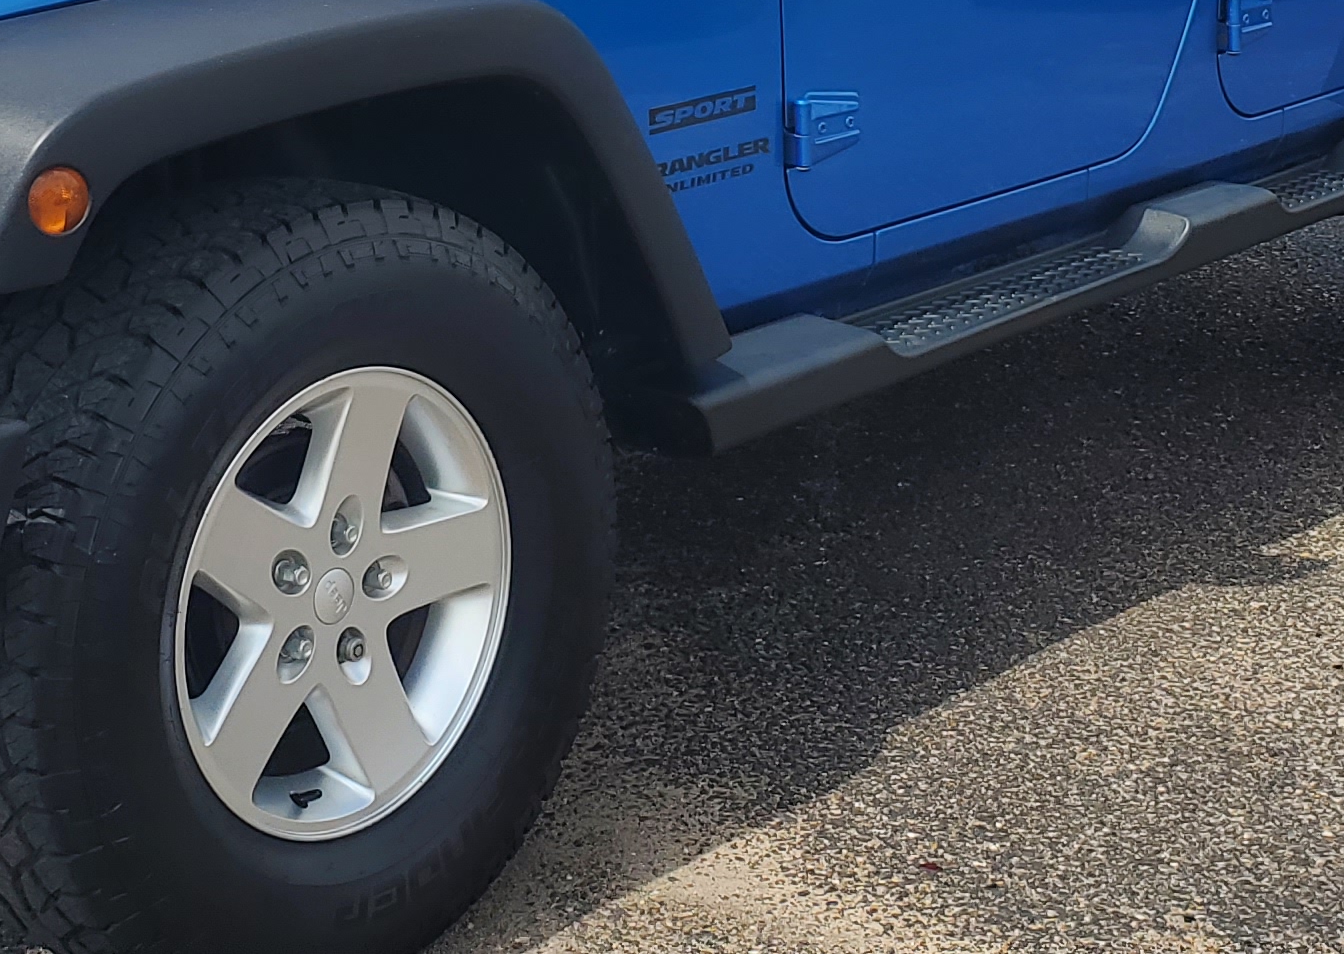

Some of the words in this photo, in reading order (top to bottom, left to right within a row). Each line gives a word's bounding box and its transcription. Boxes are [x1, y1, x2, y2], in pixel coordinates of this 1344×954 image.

[649, 91, 756, 129] SPORT
[656, 137, 770, 177] RANGLER
[665, 163, 755, 193] NLIMITED
